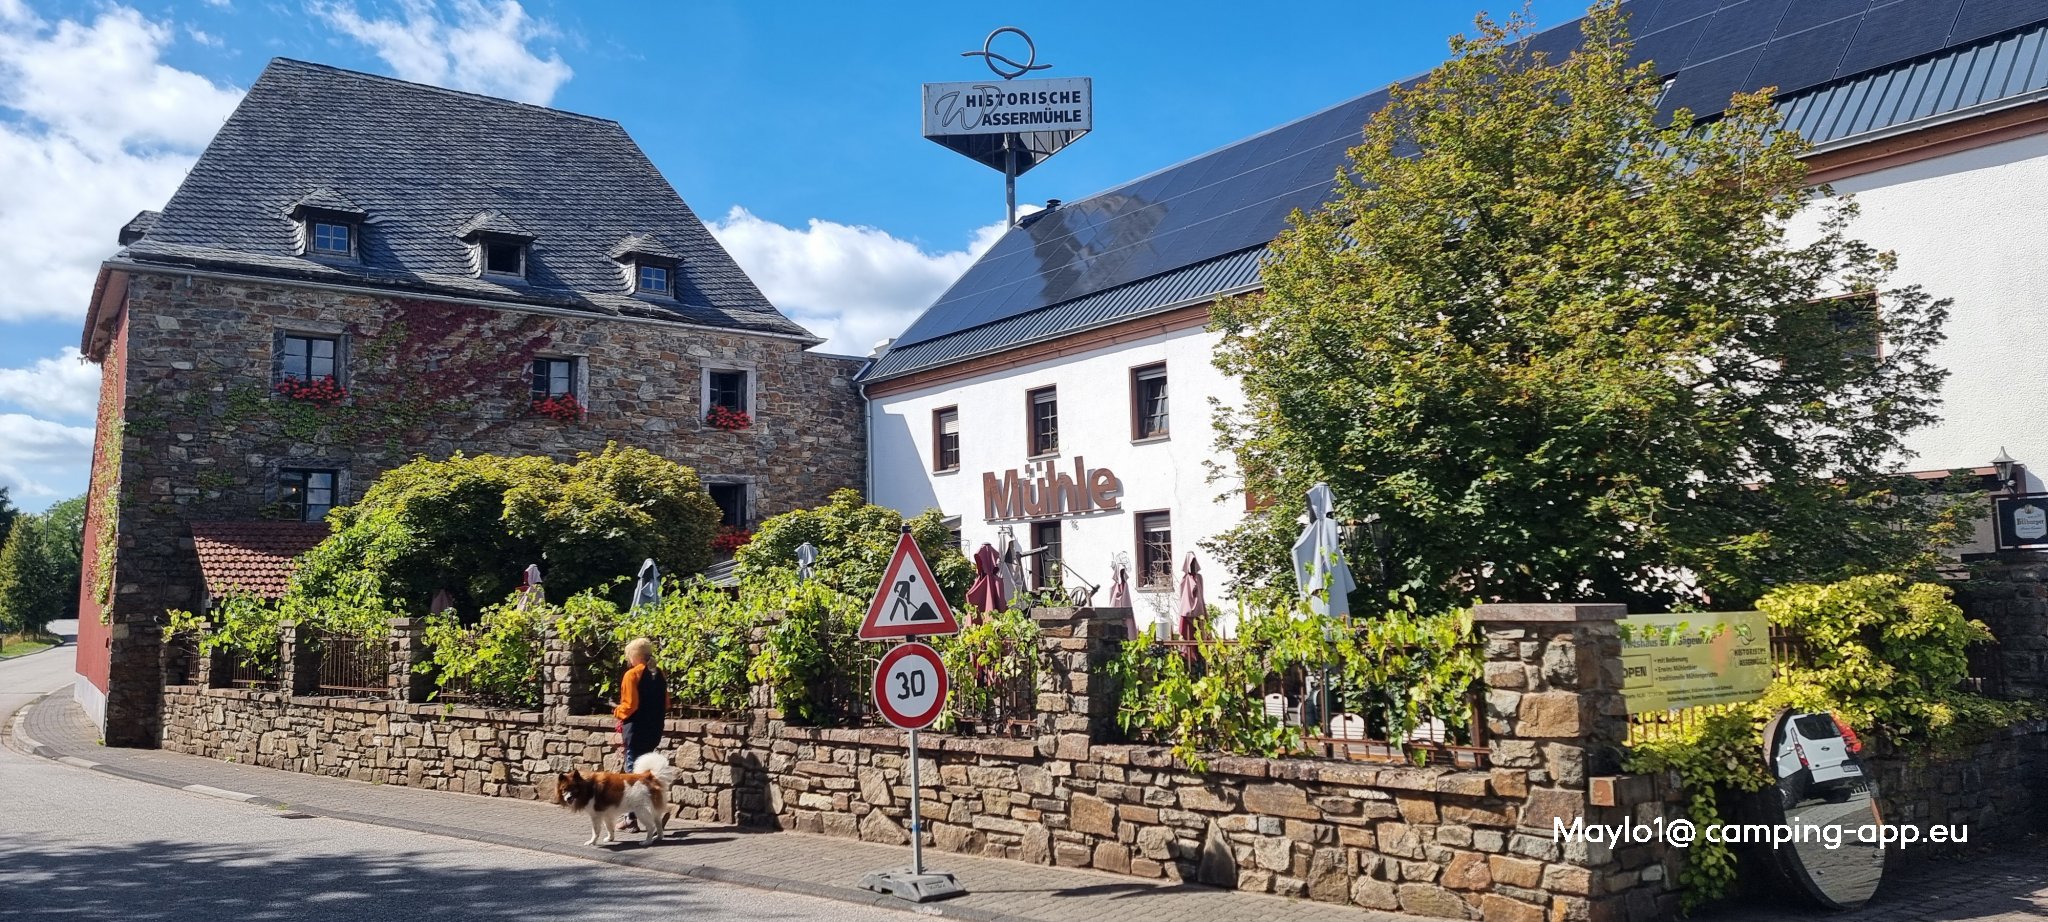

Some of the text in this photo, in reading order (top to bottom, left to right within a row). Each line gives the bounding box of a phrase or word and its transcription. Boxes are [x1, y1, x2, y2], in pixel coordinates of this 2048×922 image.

[966, 90, 1081, 108] HISTORISCHE
[982, 456, 1118, 520] Mühle
[895, 669, 926, 700] 30
